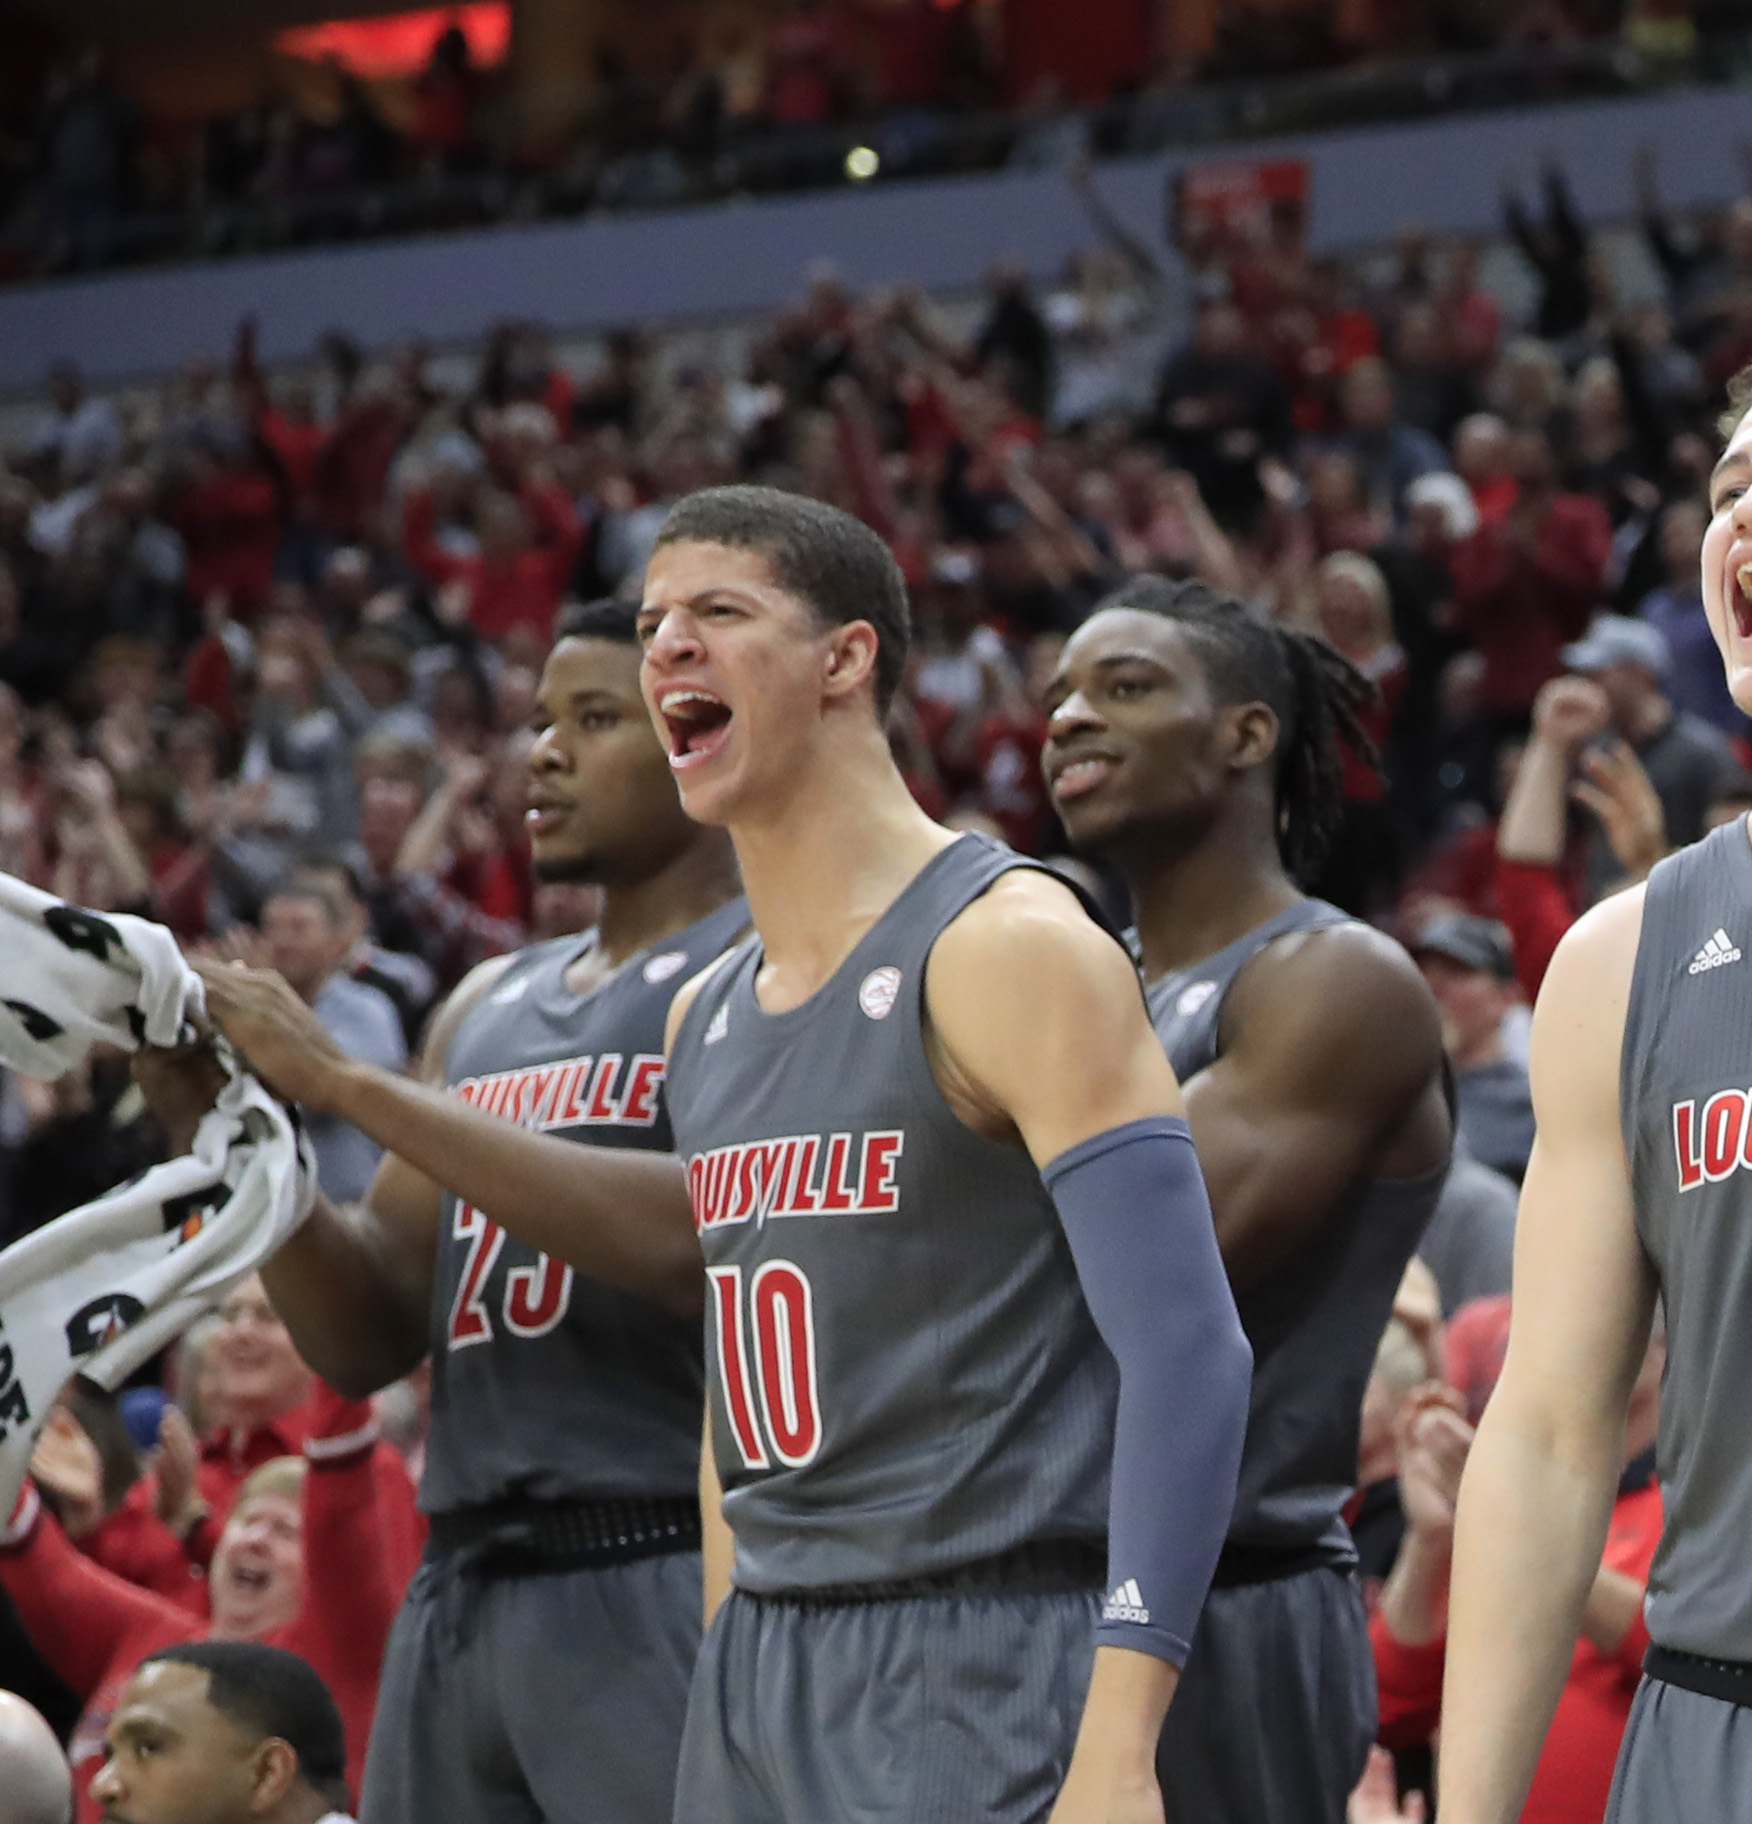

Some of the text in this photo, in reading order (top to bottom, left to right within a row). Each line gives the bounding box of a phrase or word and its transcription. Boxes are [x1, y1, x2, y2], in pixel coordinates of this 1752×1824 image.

[1688, 946, 1742, 975] adidas
[683, 1130, 904, 1237] OUISVILLE
[705, 1257, 823, 1470] 10
